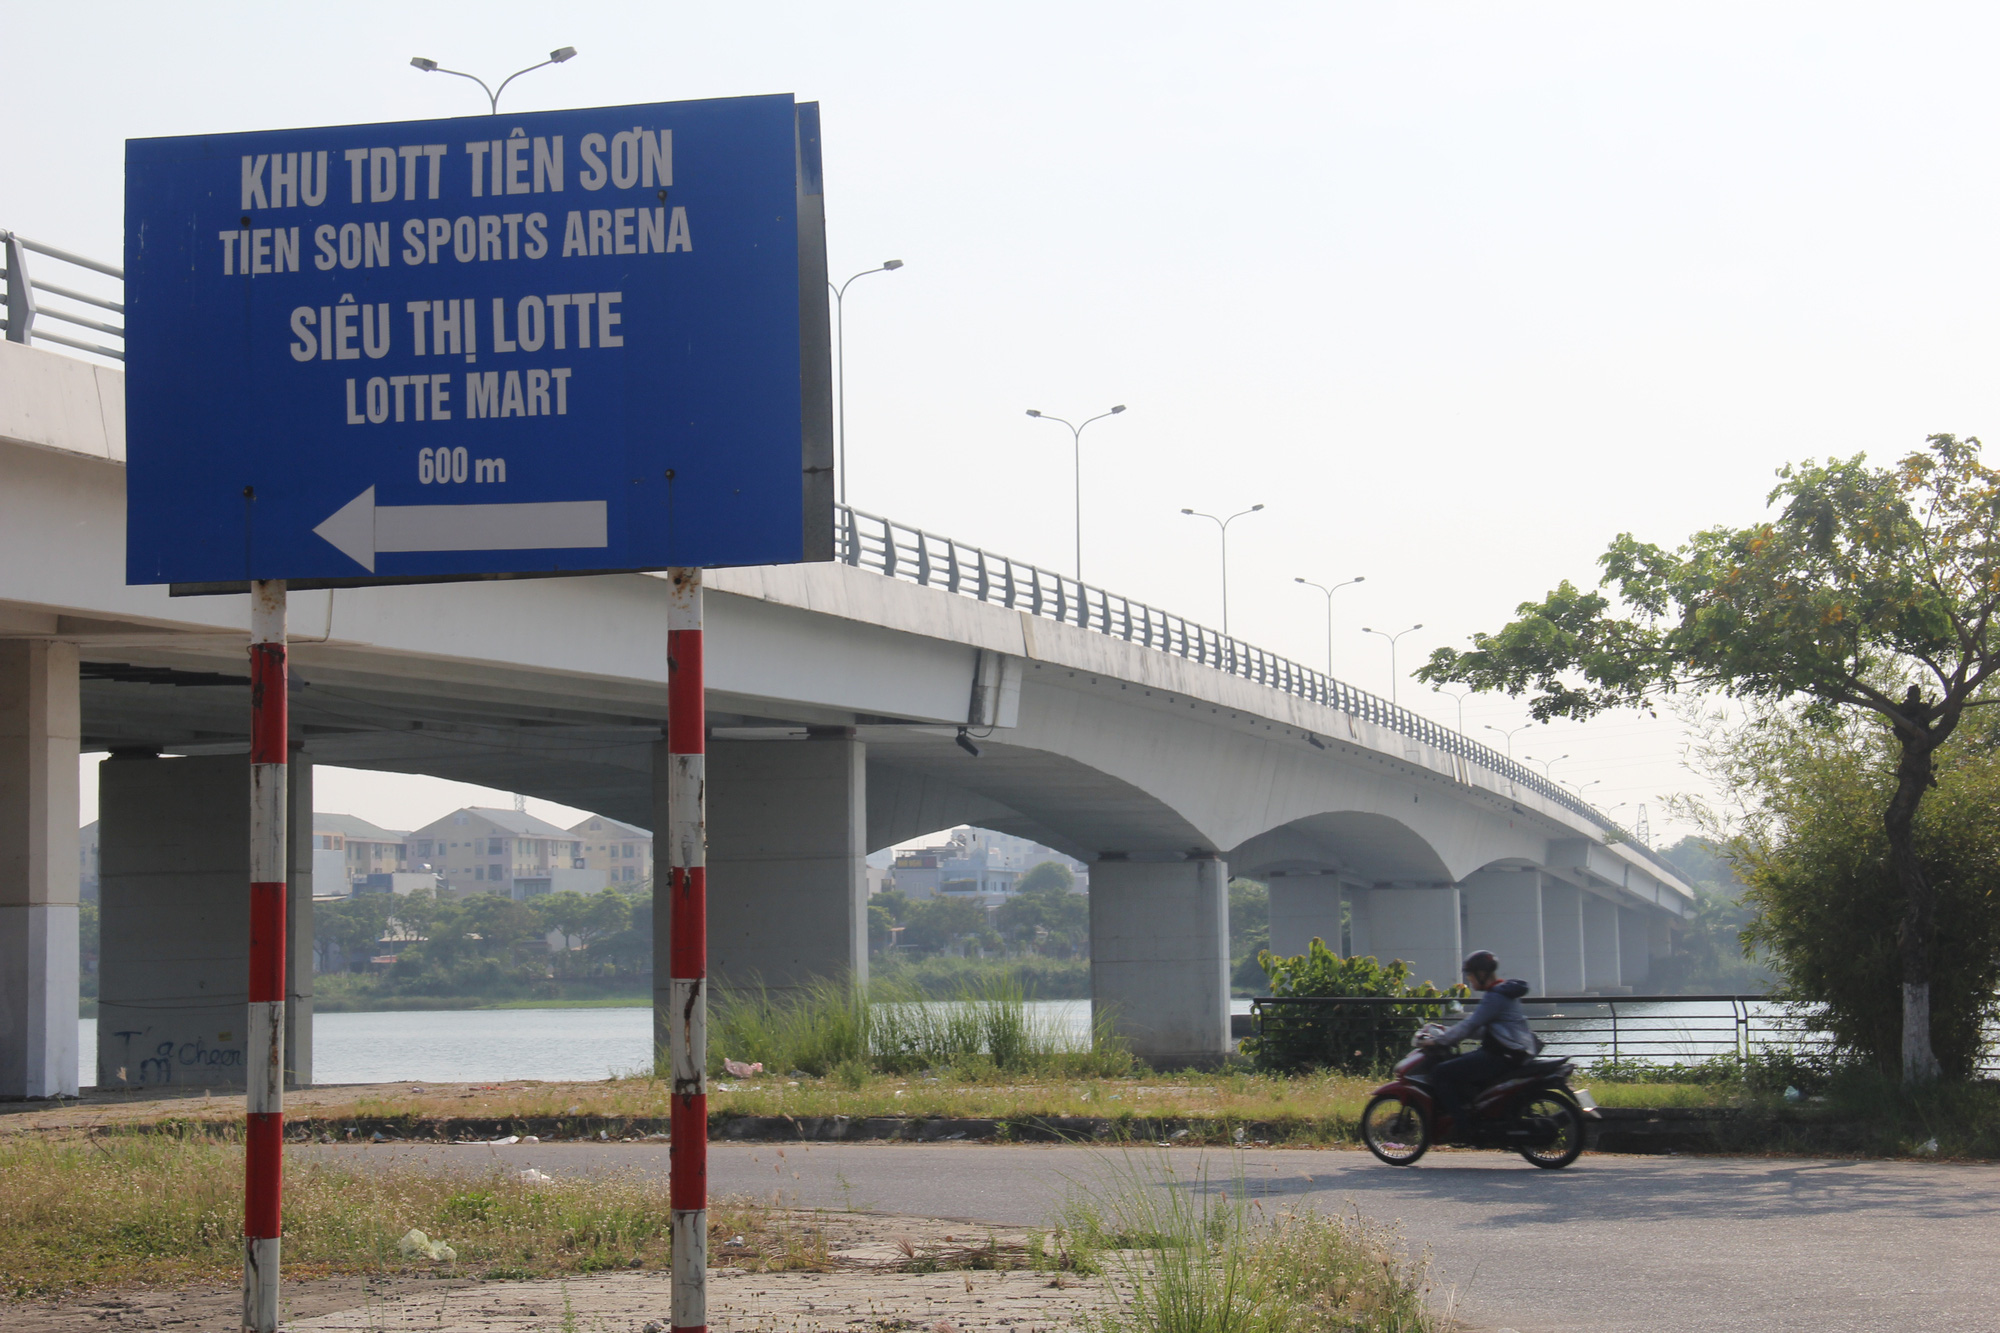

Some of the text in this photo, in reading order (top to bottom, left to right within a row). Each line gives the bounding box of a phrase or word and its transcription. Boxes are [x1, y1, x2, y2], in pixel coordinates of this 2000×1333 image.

[241, 125, 673, 210] KHU TDTT TIÊN SƠN
[218, 206, 693, 276] TIEN SON SPORTS ARENA
[290, 291, 624, 364] SIÊU THỊ LOTTE
[346, 367, 572, 425] LOTTE MART
[418, 446, 506, 485] 600 m
